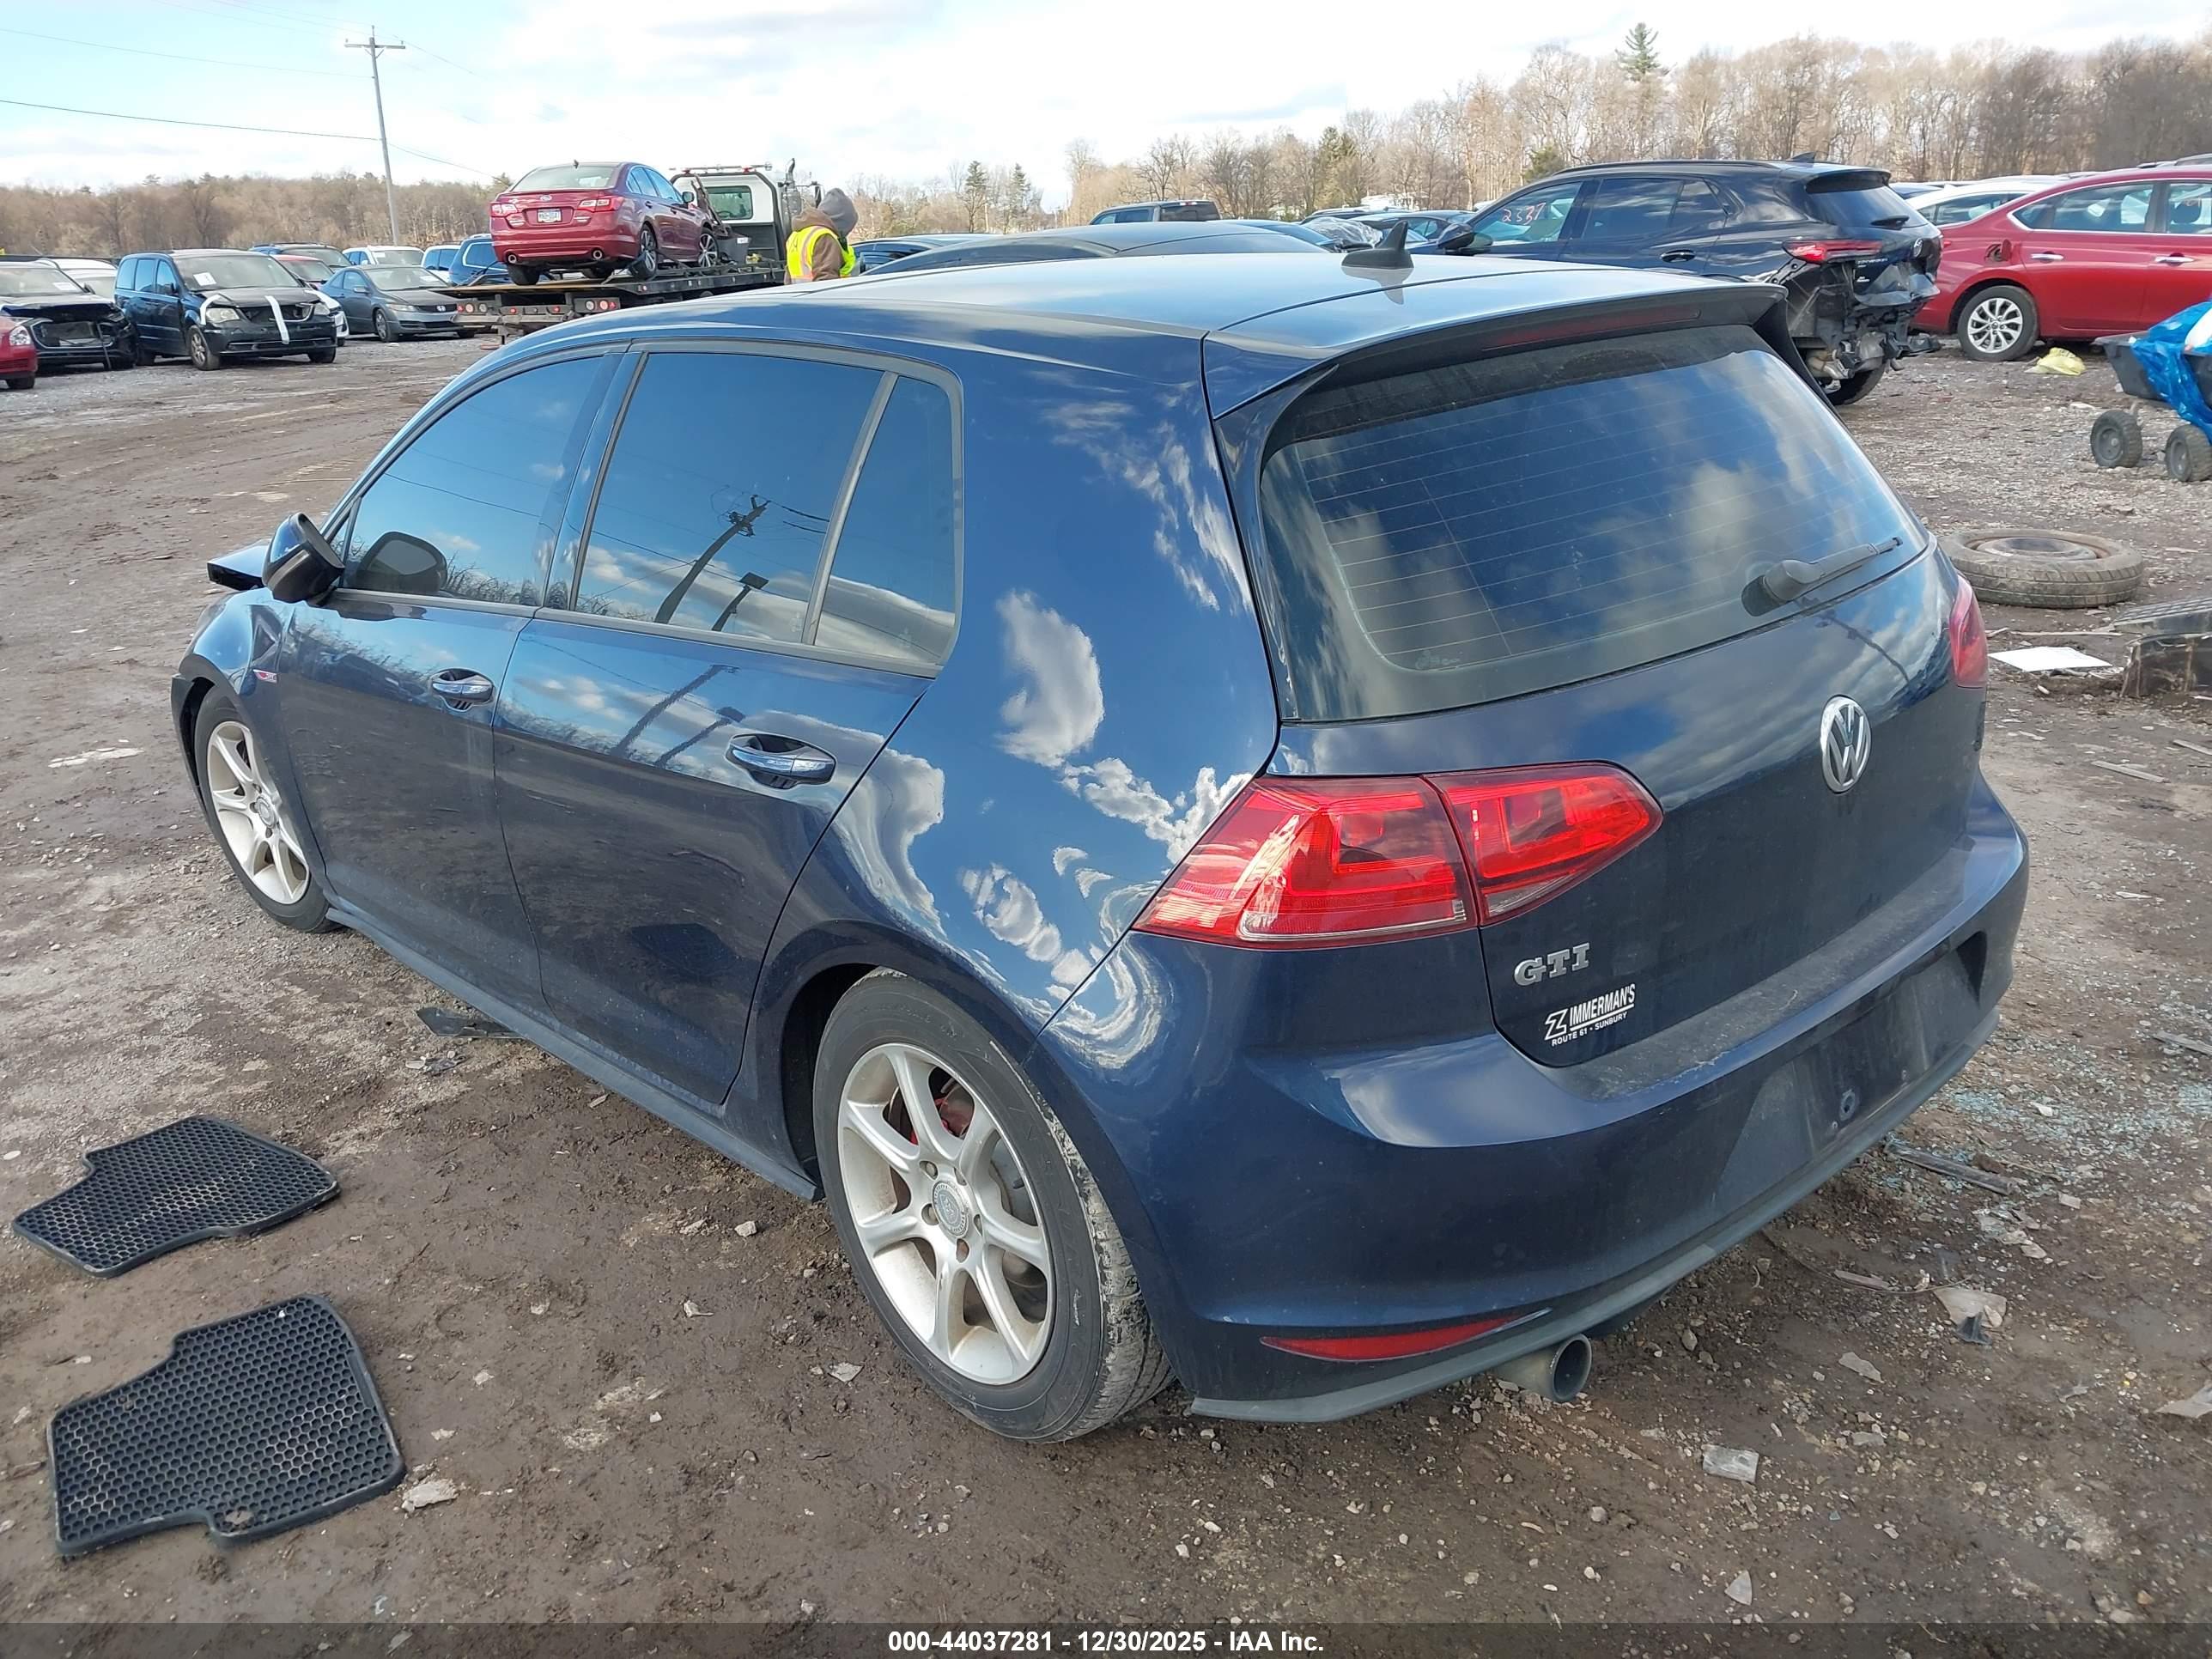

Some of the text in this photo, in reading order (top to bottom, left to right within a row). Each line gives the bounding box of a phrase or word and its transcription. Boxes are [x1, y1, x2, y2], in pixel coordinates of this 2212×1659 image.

[1513, 942, 1591, 987] GTI
[1544, 983, 1636, 1041] ZIMMERMAN'S
[1552, 1011, 1628, 1047] ROUTE 61 SUNBURY
